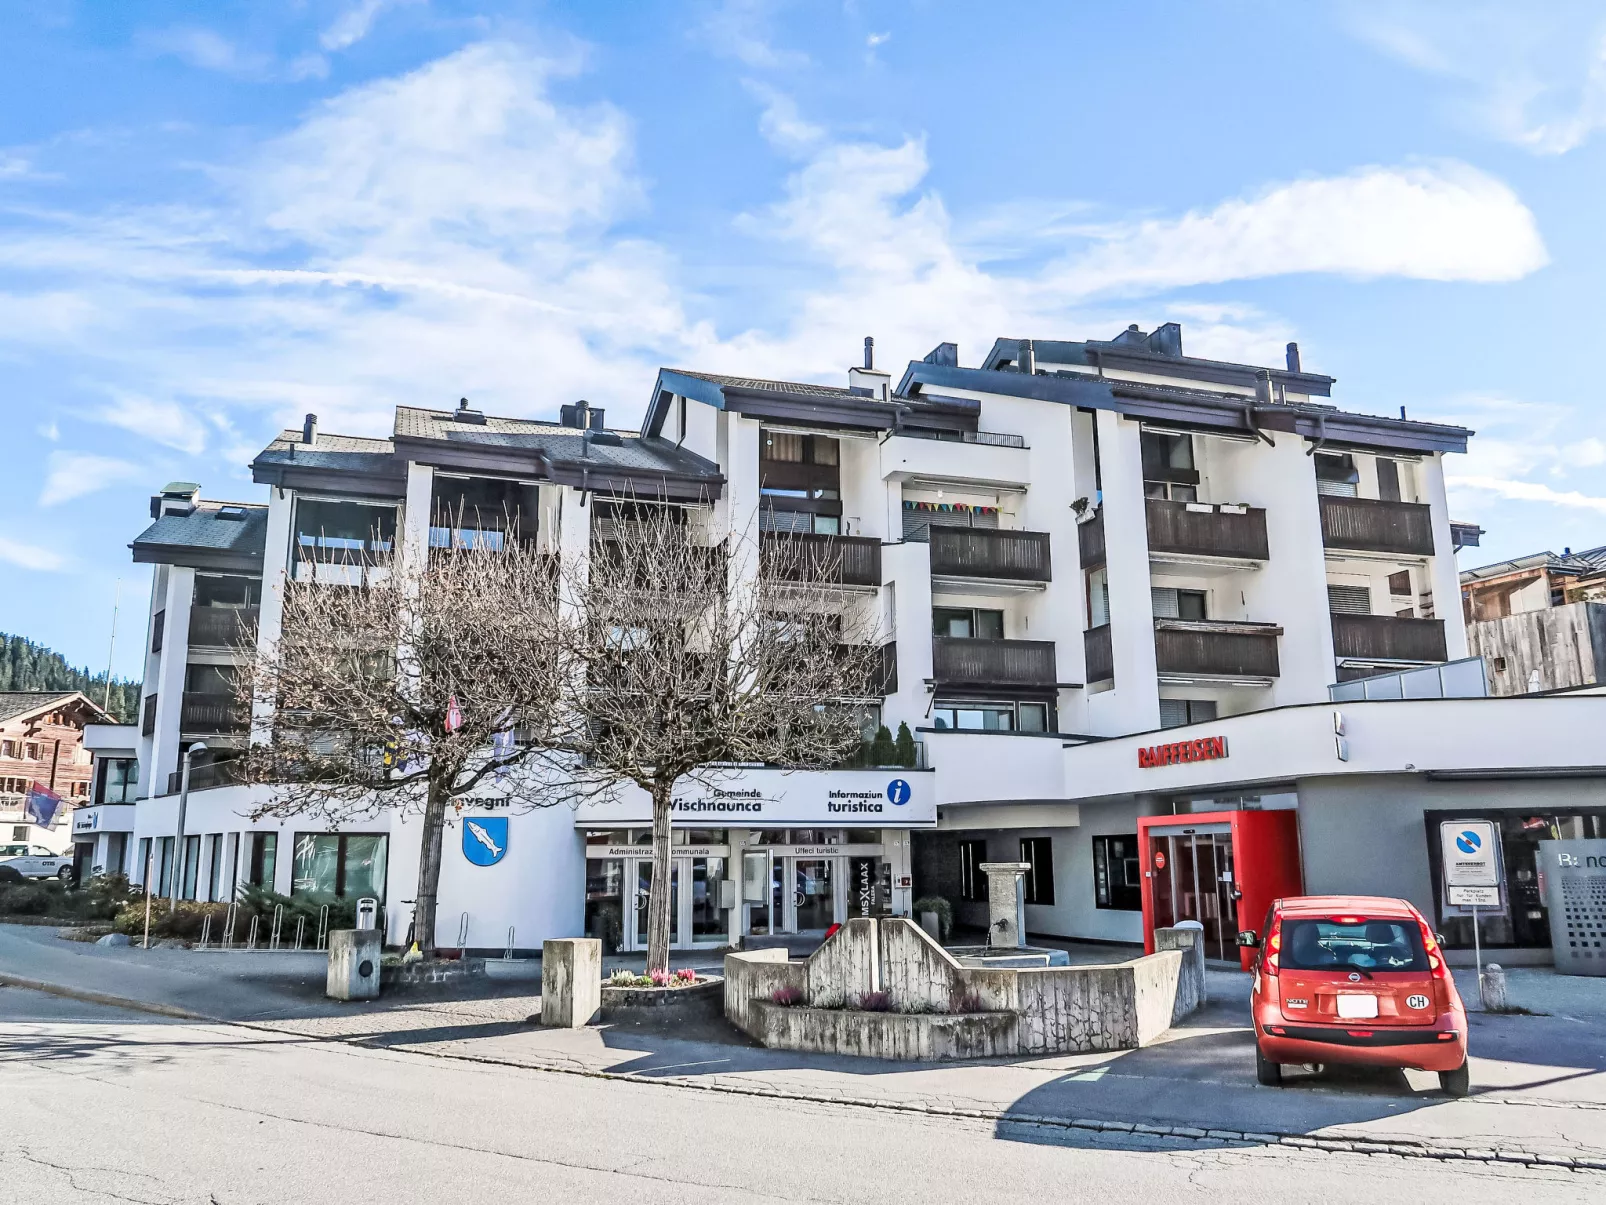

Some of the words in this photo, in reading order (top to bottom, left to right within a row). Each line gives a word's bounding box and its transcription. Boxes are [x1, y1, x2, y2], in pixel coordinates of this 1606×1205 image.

[1138, 736, 1226, 768] RAIFFEISEN
[713, 789, 761, 798] Gemeinde
[829, 790, 883, 799] Informaziun
[670, 798, 762, 812] Vischnaunca
[828, 799, 883, 813] turistica
[671, 848, 710, 856] ommunala
[795, 847, 814, 855] Uffeci
[816, 847, 839, 855] turistic
[1409, 996, 1425, 1008] CH
